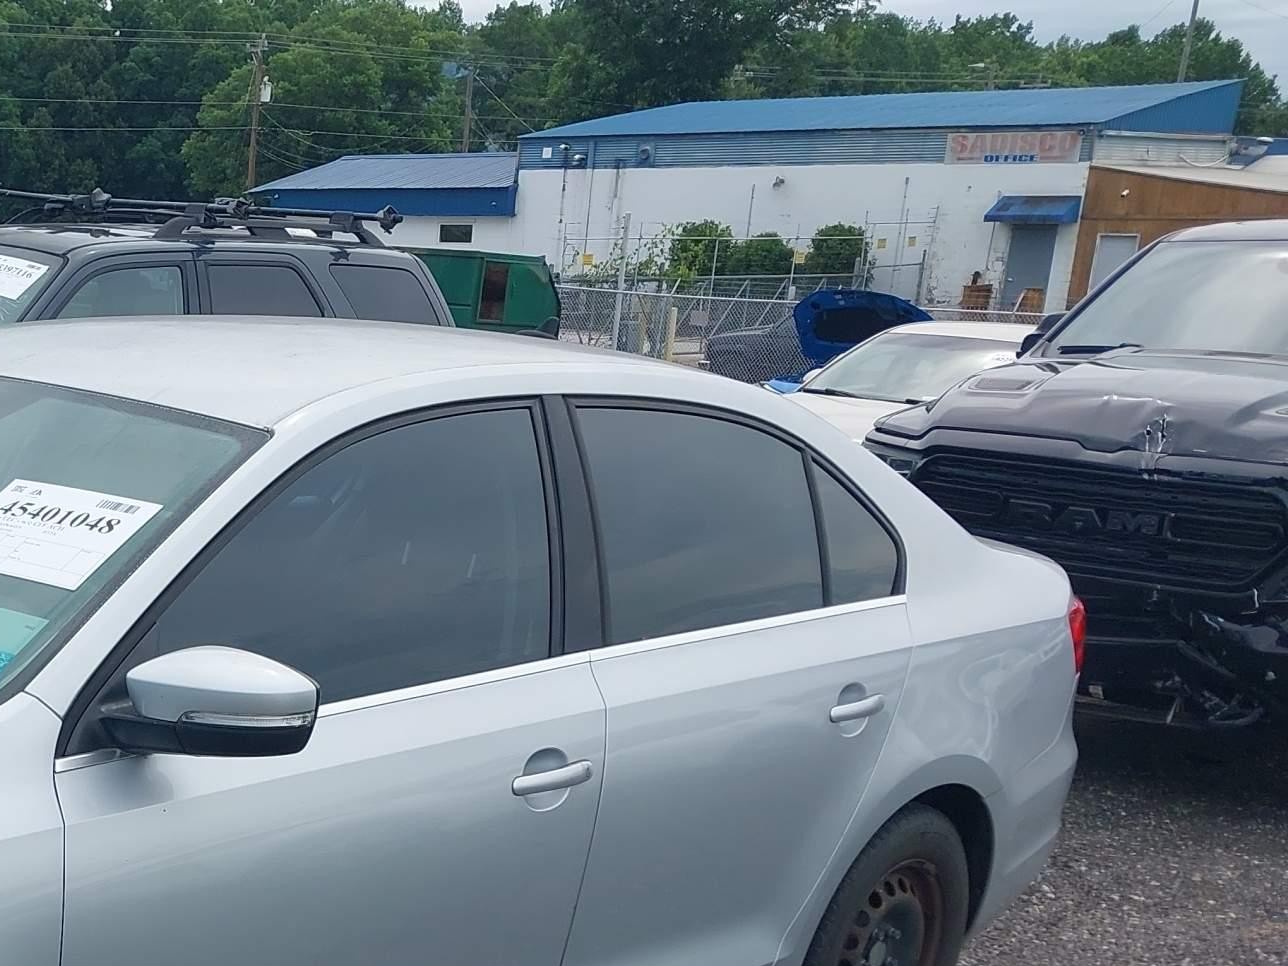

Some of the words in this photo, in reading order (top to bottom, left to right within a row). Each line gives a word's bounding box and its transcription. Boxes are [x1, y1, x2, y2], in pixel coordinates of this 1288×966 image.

[951, 132, 1081, 155] SADISCO
[983, 154, 1040, 163] OFFICE
[0, 500, 121, 534] 45401048
[1009, 499, 1159, 537] RAM
